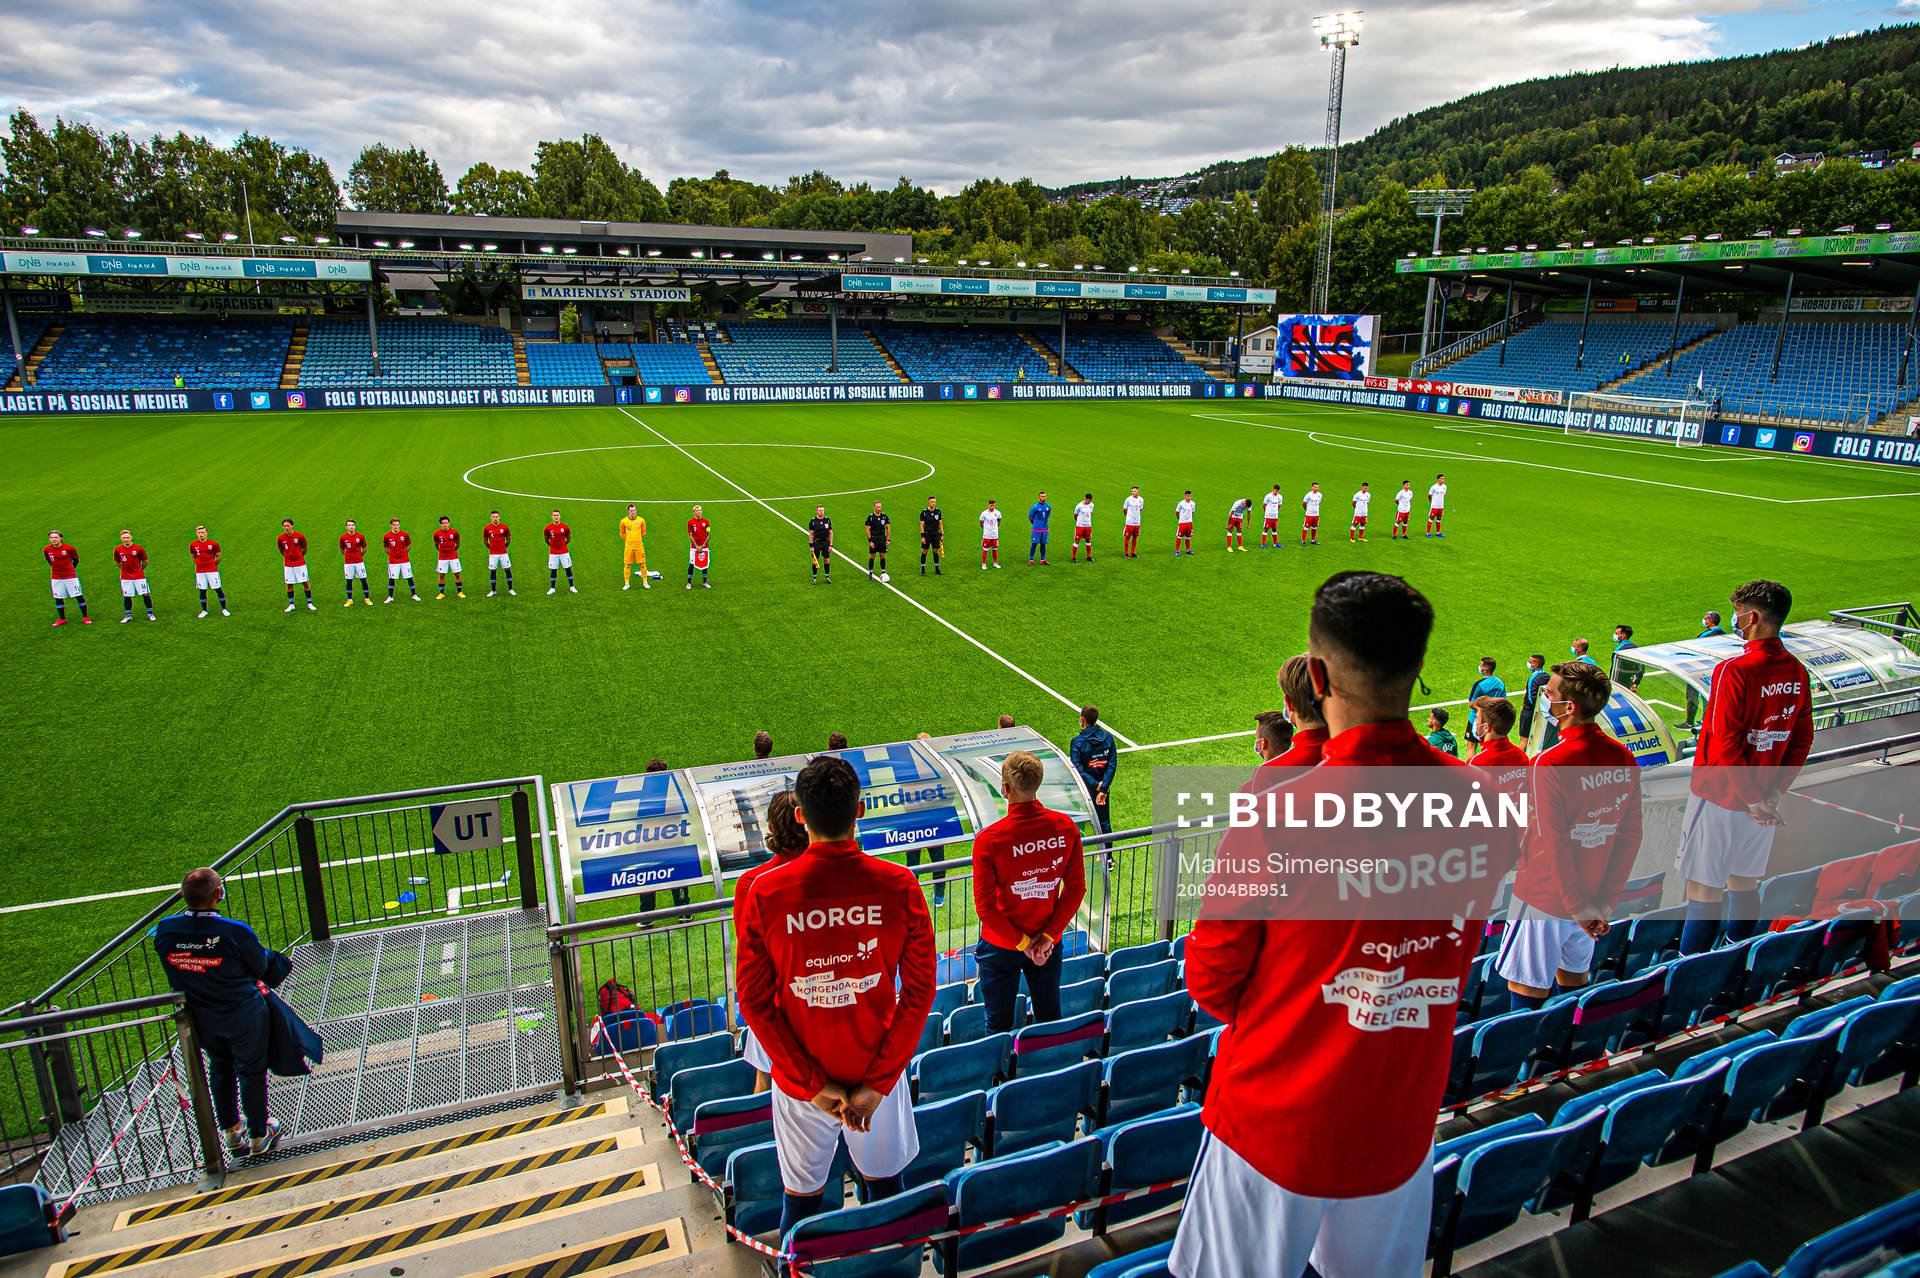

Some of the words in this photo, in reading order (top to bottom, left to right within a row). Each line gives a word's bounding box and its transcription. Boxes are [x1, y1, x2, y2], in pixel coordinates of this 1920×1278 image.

[1720, 243, 1747, 257] KIWI
[1823, 238, 1856, 253] KIWI
[1632, 249, 1655, 261] KIWI
[18, 257, 42, 269] DNB
[101, 258, 123, 271] DNB
[180, 260, 200, 272] DNB
[255, 262, 276, 275] DNB
[328, 263, 347, 276] DNB
[848, 278, 862, 288] DNB
[541, 287, 625, 299] MARIENLYST
[630, 288, 687, 300] STADION
[210, 298, 273, 310] ISACHSEN
[1801, 299, 1829, 310] HOBRO
[1831, 299, 1855, 310] BYGG
[1013, 385, 1034, 398] FØLG
[1036, 384, 1115, 397] FOTBALLANDSLAGET
[1117, 383, 1128, 397] PÅ
[1129, 384, 1161, 397] SOSIALE
[1162, 384, 1191, 397] MEDIER
[1365, 378, 1377, 387] RVS
[1378, 379, 1387, 388] AS
[1455, 384, 1492, 397] Canon
[325, 391, 356, 407] FØLG
[360, 389, 479, 406] FOTBALLANDSLAGET
[484, 388, 498, 405] PÅ
[501, 389, 549, 404] SOSIALE
[551, 389, 595, 404] MEDIER
[705, 387, 731, 401] FØLG
[733, 386, 831, 401] FOTBALLANDSLAGET
[833, 385, 846, 400] PÅ
[848, 385, 887, 400] SOSIALE
[888, 385, 924, 399] MEDIER
[1283, 386, 1342, 402] FOTBALLANDSLAGET
[1342, 388, 1351, 402] PÅ
[1351, 390, 1379, 405] SOSIALE
[1379, 394, 1406, 408] MEDIER
[48, 393, 68, 411] PÅ
[71, 394, 131, 410] SOSIALE
[134, 393, 189, 409] MEDIER
[1481, 403, 1501, 417] FØLG
[1593, 412, 1608, 430] PÅ
[1609, 415, 1653, 435] SOSIALE
[1833, 436, 1871, 457] FØLG
[1805, 650, 1852, 667] vinduet
[1833, 673, 1871, 689] Fjerdingstad
[1761, 682, 1801, 698] NORGE
[714, 766, 793, 779] generasjoner
[722, 763, 766, 772] Kvalitet
[1498, 768, 1527, 785] NORGE
[1581, 768, 1632, 791] NORGE
[860, 783, 947, 810] induet
[454, 811, 493, 841] UT
[580, 819, 691, 851] vinduet
[885, 827, 939, 844] Magnor
[1012, 836, 1066, 857] NORGE
[611, 867, 675, 887] Magnor
[1022, 867, 1050, 876] equinor
[1337, 844, 1488, 900] NORGE
[786, 905, 883, 934] NORGE
[176, 942, 204, 950] equinor
[1361, 935, 1441, 964] equinor
[805, 954, 853, 969] equinor
[805, 974, 831, 984] STØTTER
[1353, 970, 1399, 983] STØTTER
[796, 977, 874, 995] MORGENDAGENS
[811, 993, 850, 1005] HELTER
[1356, 1008, 1419, 1027] HELTER
